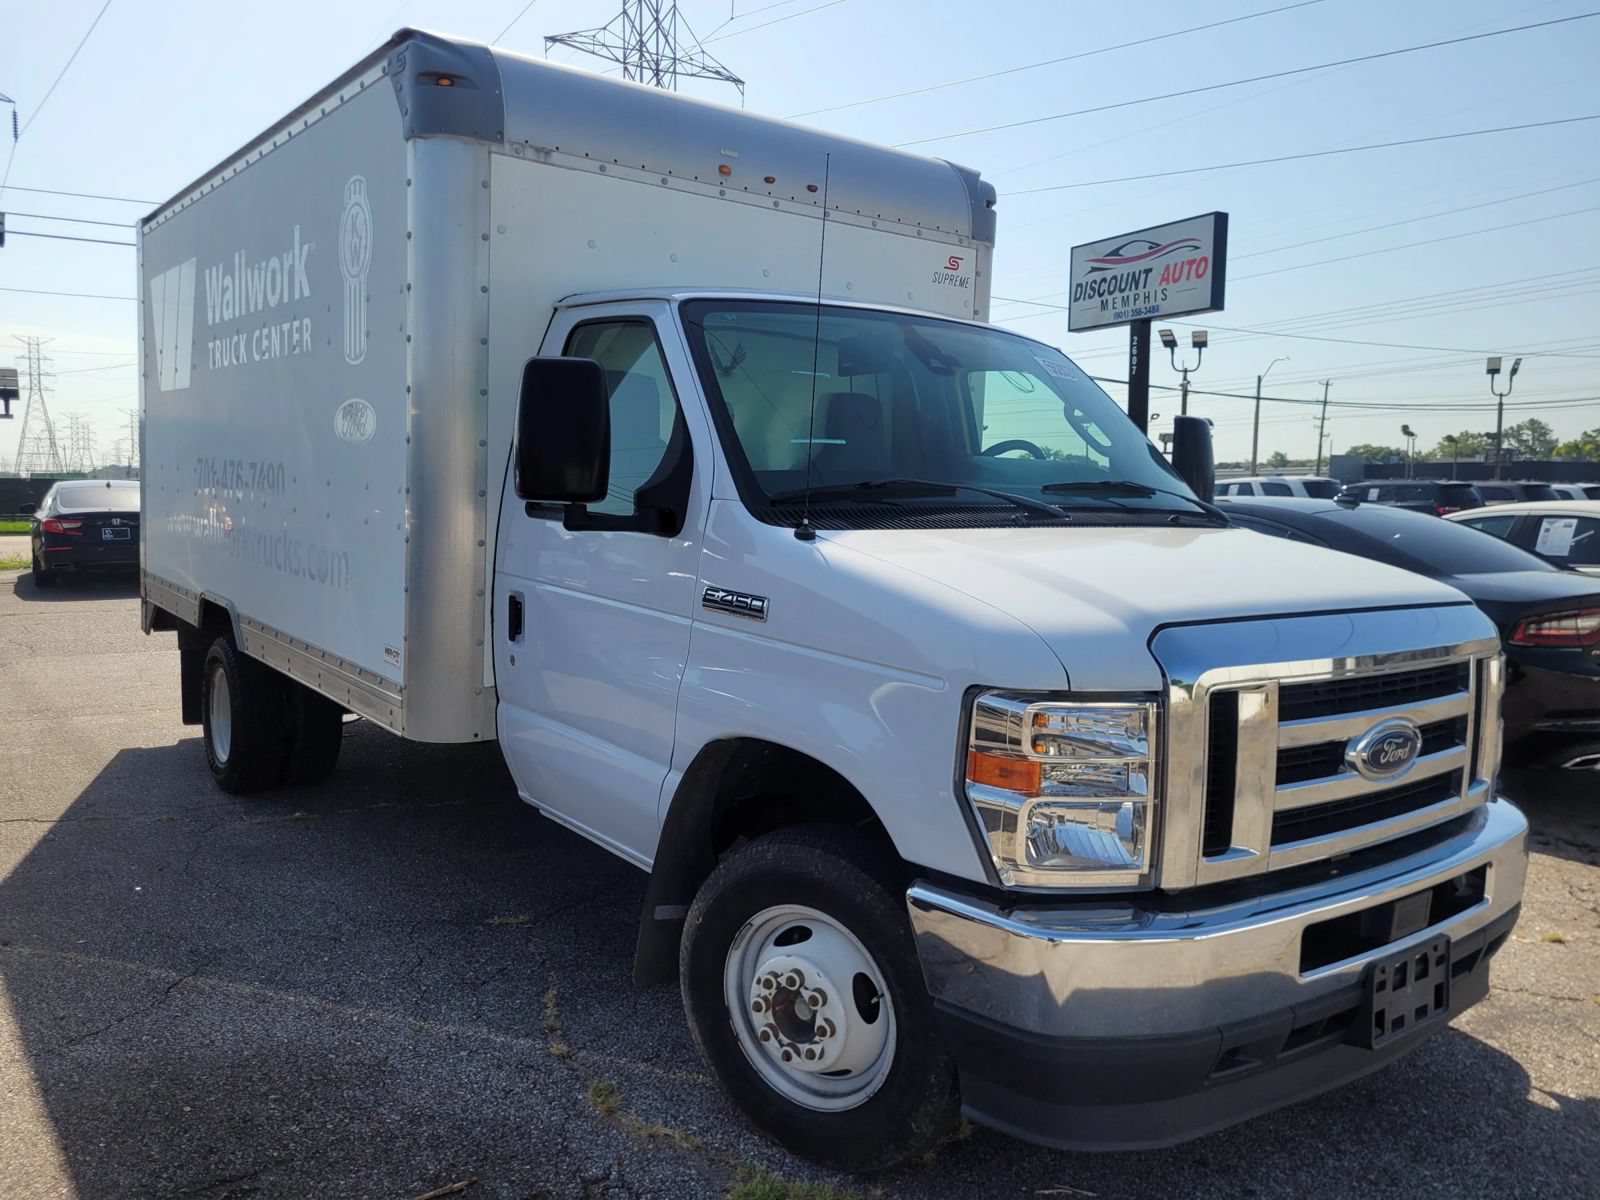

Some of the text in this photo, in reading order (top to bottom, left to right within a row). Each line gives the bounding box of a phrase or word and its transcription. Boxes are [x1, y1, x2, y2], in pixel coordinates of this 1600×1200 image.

[205, 224, 311, 325] Wallwork
[932, 272, 970, 288] SUPREME
[1073, 256, 1209, 302] DISCOUNT AUTO
[1101, 288, 1168, 312] MEMPHIS
[208, 318, 312, 370] TRUCK CENTER
[1380, 738, 1411, 764] Ford
